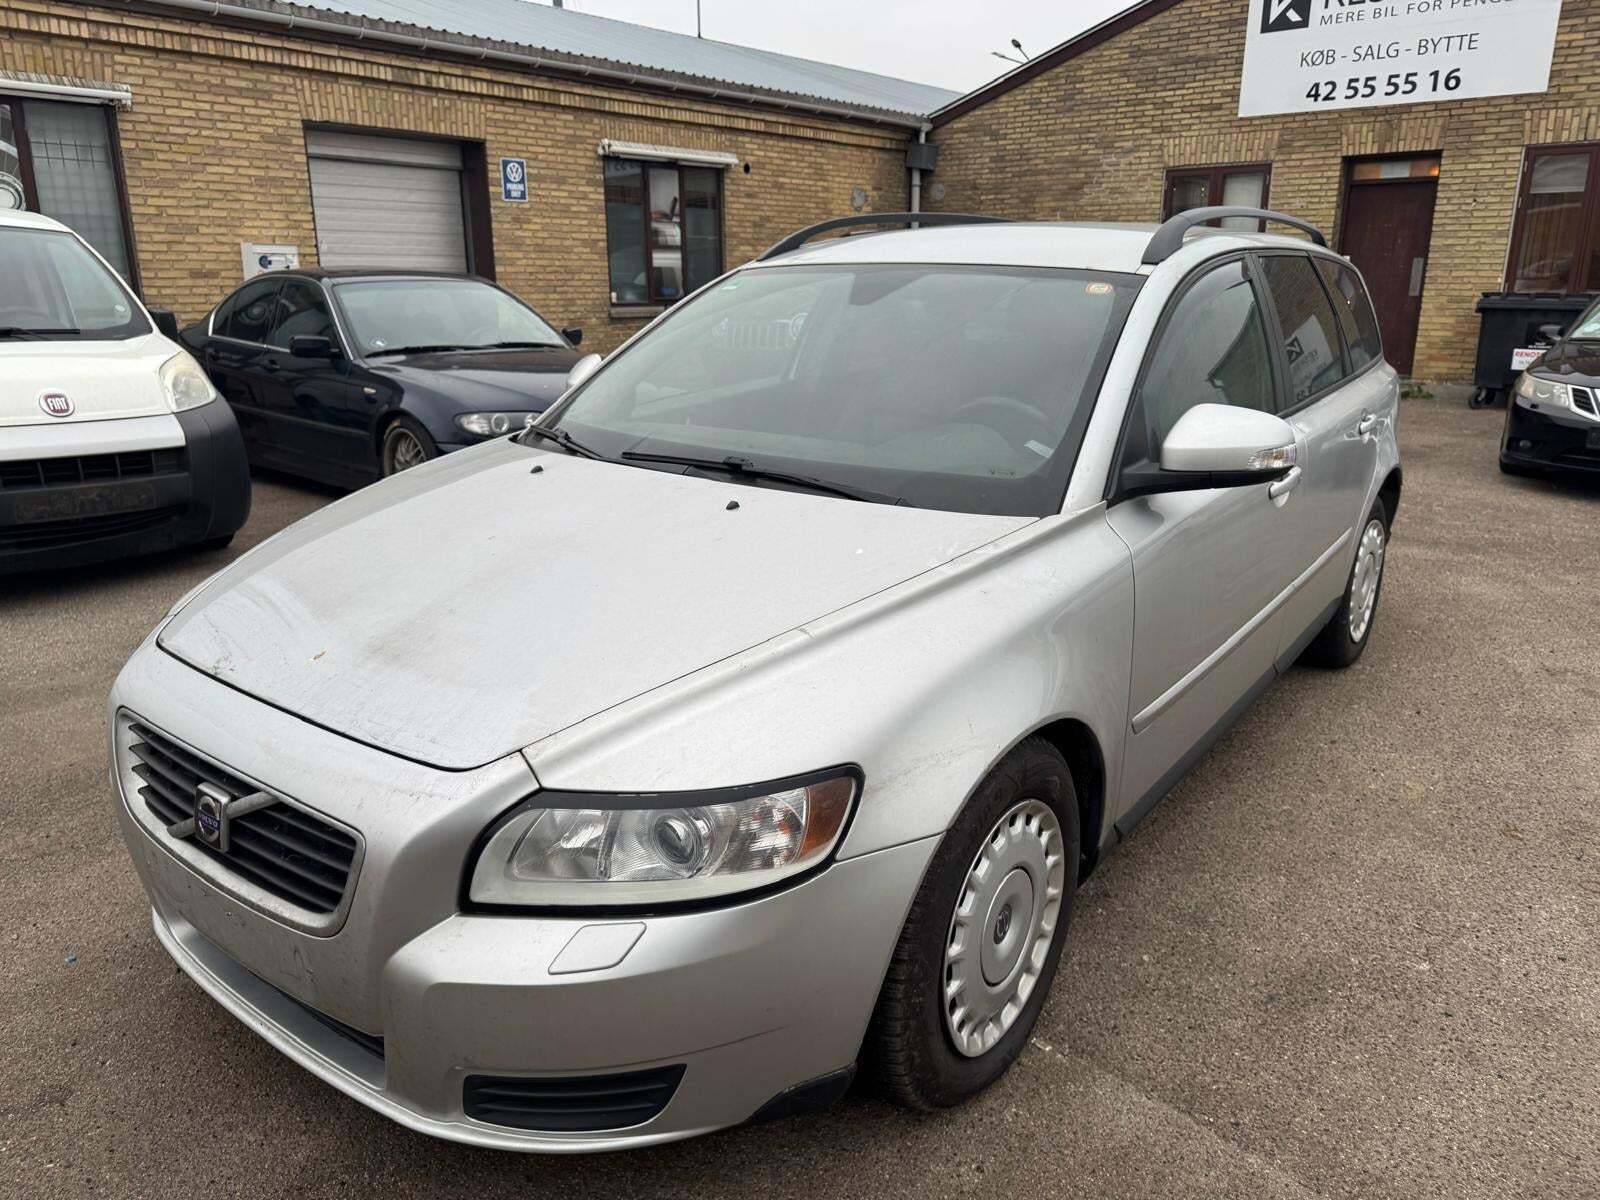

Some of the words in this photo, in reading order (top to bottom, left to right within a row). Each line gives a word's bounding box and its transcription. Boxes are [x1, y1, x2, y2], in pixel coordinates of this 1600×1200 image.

[1319, 9, 1366, 26] MERE
[1372, 6, 1399, 19] BIL
[1406, 0, 1443, 15] FOR
[1300, 49, 1336, 68] KØB
[1352, 41, 1400, 63] SALG
[1417, 32, 1480, 56] BYTTE
[1305, 80, 1337, 102] 42
[1344, 76, 1377, 100] 55
[1384, 71, 1418, 97] 55
[1429, 67, 1461, 92] 16
[46, 397, 68, 411] FIAT
